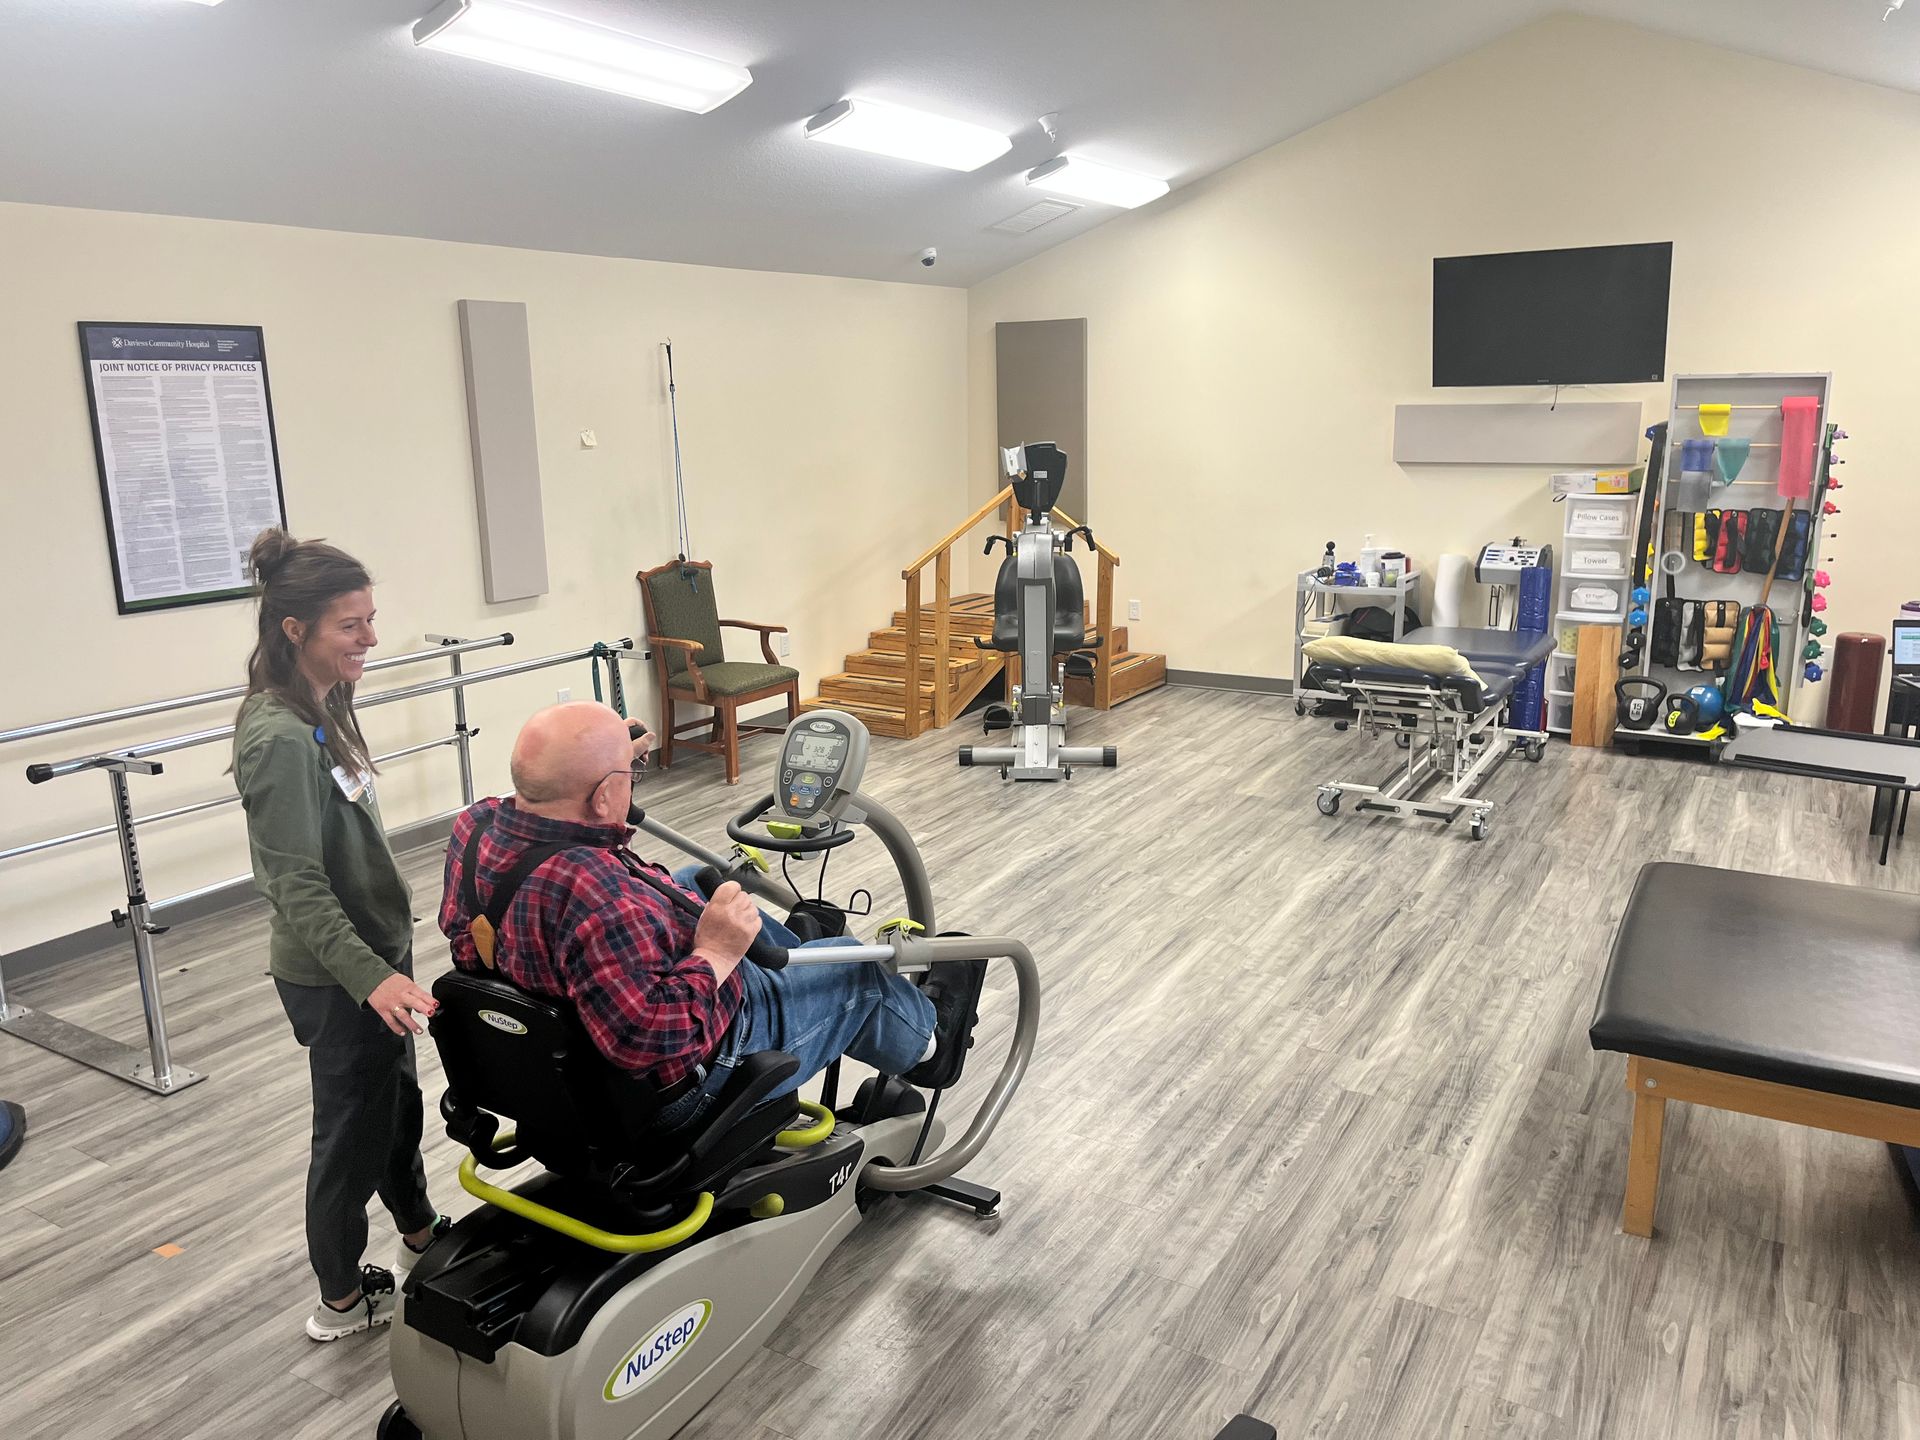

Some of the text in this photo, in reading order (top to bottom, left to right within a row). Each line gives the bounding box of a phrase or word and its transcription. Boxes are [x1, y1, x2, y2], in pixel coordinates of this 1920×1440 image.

[148, 339, 185, 349] Community
[185, 340, 210, 349] Hospital
[99, 363, 257, 373] JOINT NOTICE OF PRIVACY PRACTICES
[1577, 513, 1597, 521] Pillow
[1633, 703, 1642, 711] 15
[488, 1014, 518, 1029] NuStep
[626, 1317, 694, 1384] NuStep
